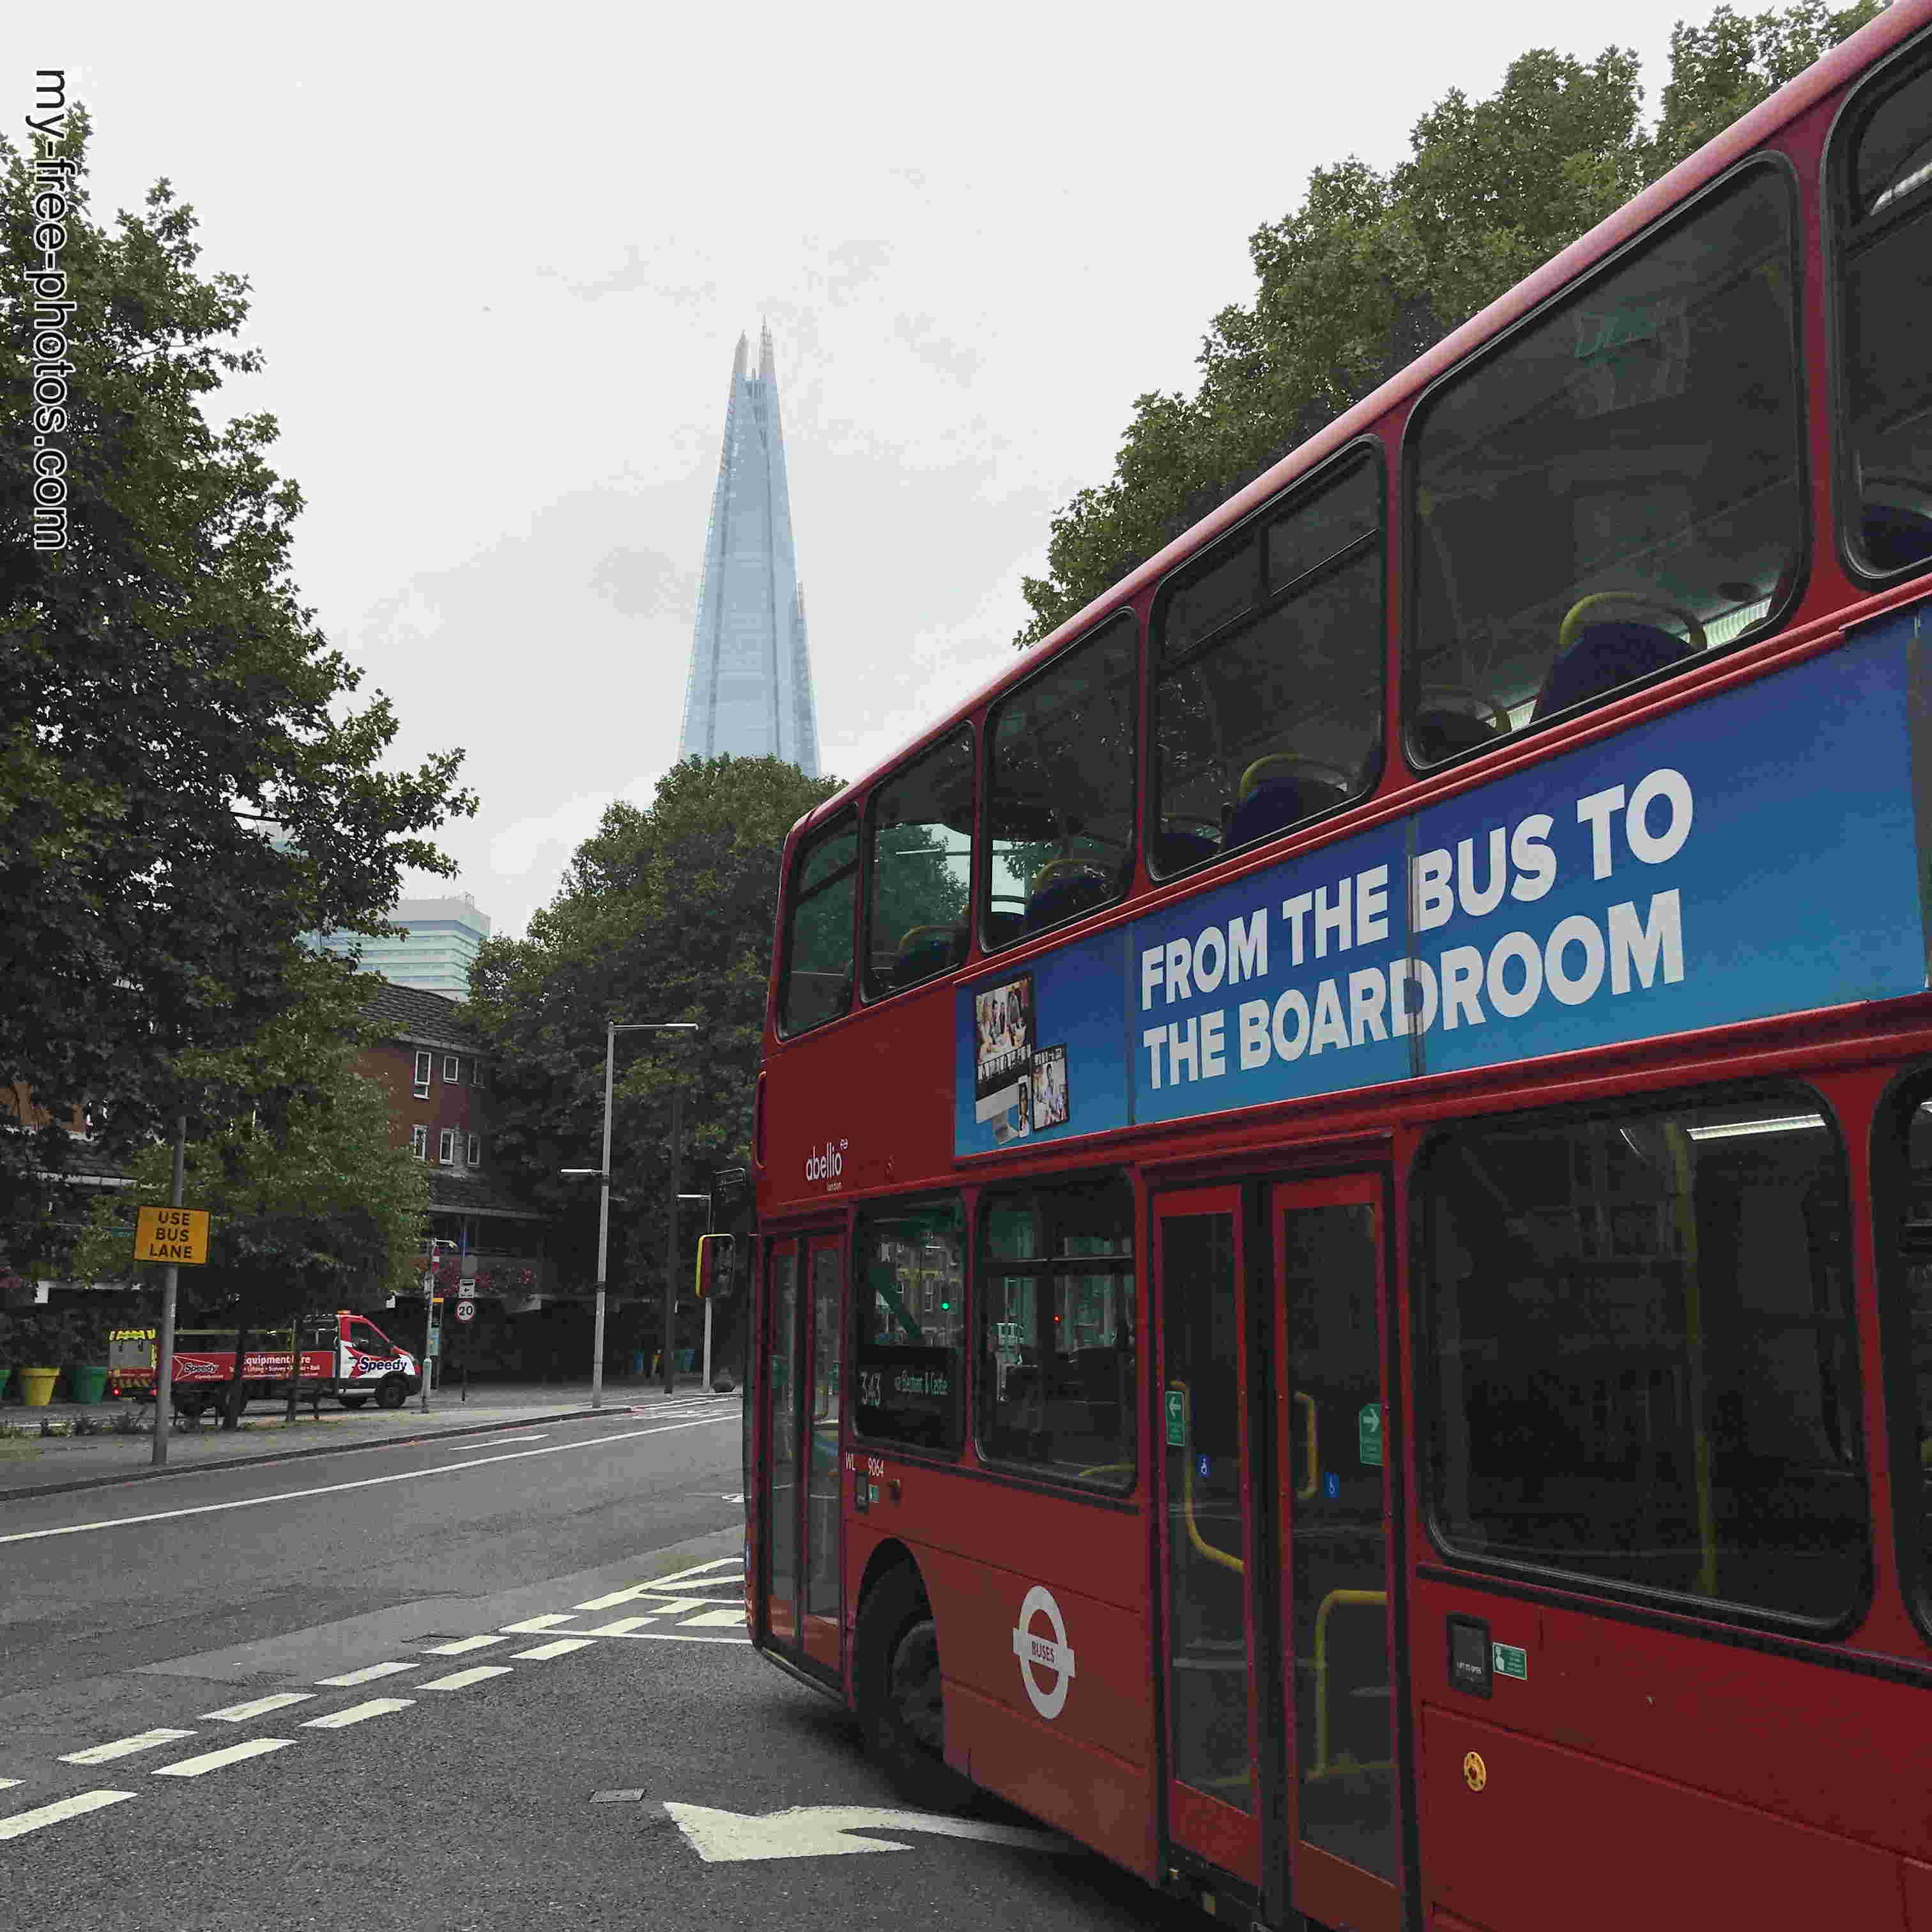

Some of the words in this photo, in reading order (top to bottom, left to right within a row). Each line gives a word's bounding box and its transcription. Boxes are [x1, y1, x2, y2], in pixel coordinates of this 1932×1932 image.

[1142, 908, 1268, 1010] FROM
[1283, 864, 1388, 965] THE
[1409, 815, 1557, 933] BUS
[1577, 769, 1693, 880] TO
[1143, 1009, 1226, 1089] THE
[1239, 889, 1684, 1070] BOARDROOM
[806, 1142, 842, 1181] abellio
[158, 1210, 190, 1225] USE
[155, 1227, 189, 1242] BUS
[148, 1243, 192, 1259] LANE
[459, 1306, 473, 1316] 20
[360, 1356, 408, 1373] Speedy
[1032, 1641, 1054, 1663] BUSES
